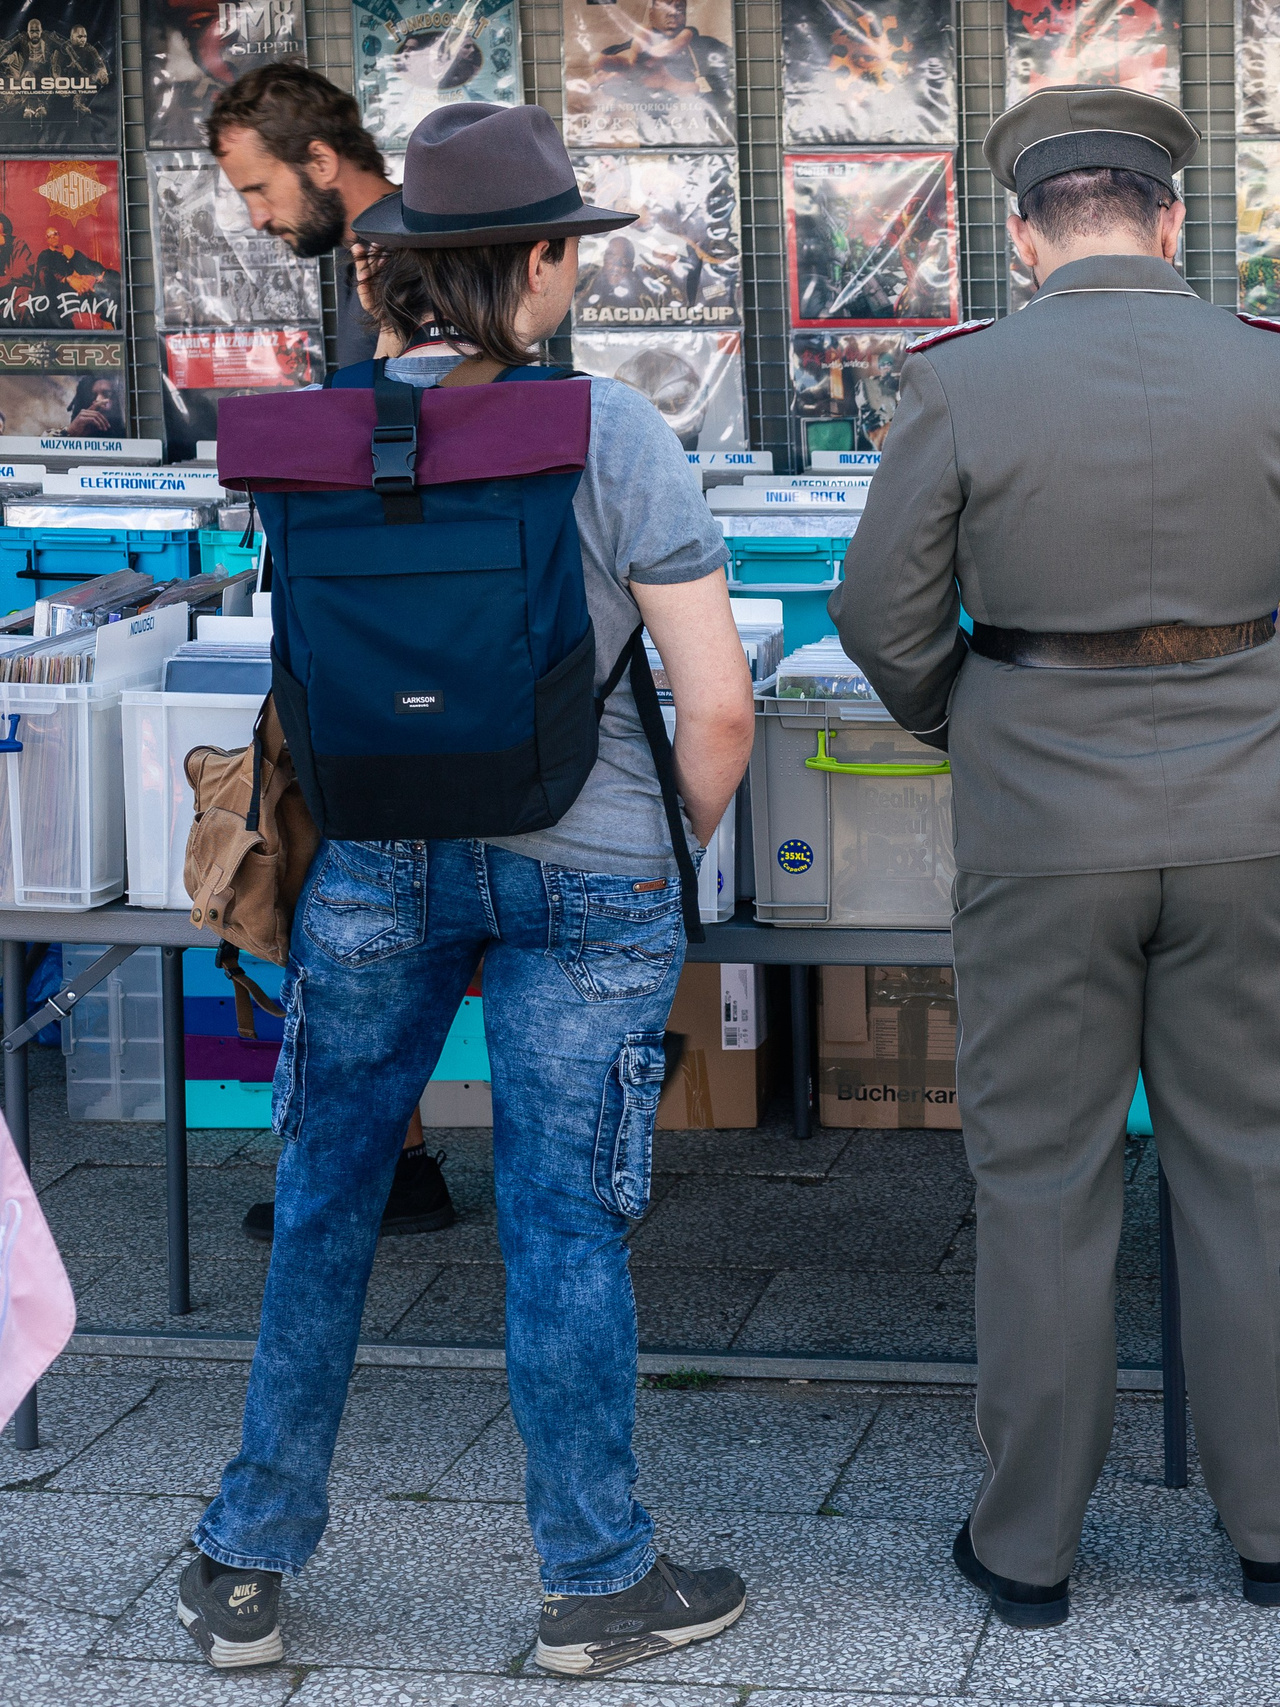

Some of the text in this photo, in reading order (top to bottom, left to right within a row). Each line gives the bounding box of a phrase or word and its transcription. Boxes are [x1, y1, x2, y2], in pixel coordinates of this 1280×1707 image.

[40, 77, 97, 90] SOUL
[583, 306, 734, 321] BACDAFUCUP
[55, 343, 121, 366] EFX
[41, 440, 122, 451] MUZYKA POLSKA
[725, 454, 756, 464] SOUL
[839, 454, 881, 464] MUZYK
[80, 477, 186, 491] ELEKTRONICZNA
[766, 491, 846, 503] INDIE ROCK
[402, 696, 435, 704] LARKSON
[784, 852, 807, 861] 35XL
[783, 862, 808, 872] Capacity
[838, 1084, 957, 1104] Bücherkar
[233, 1583, 257, 1597] NIKE
[237, 1605, 259, 1615] AIR
[543, 1605, 559, 1617] AIR
